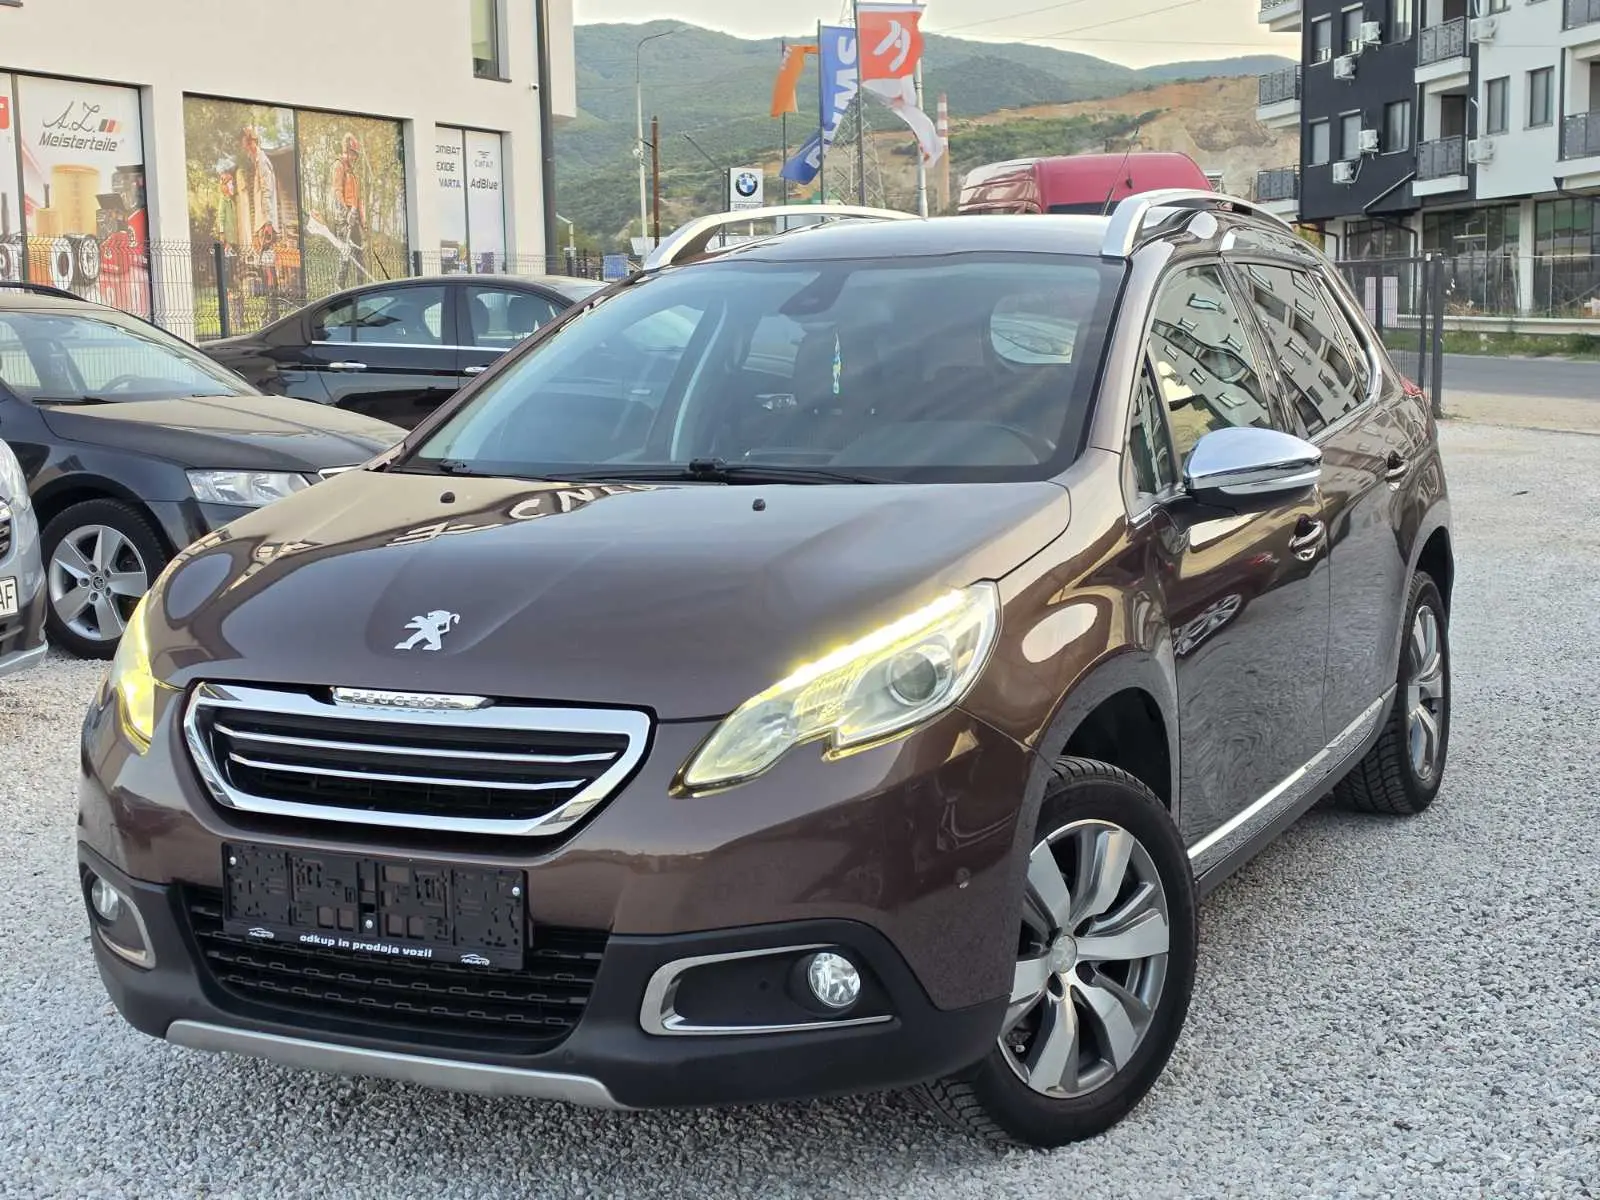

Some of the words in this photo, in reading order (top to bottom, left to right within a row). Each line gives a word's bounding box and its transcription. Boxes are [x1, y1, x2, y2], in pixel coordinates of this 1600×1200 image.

[39, 131, 118, 152] Meisterteile
[436, 161, 455, 172] EXIDE
[438, 178, 461, 188] VARTA
[470, 178, 498, 190] AdBlue
[352, 691, 451, 708] PEUGEOT
[338, 938, 350, 948] in
[352, 941, 400, 954] prodaja
